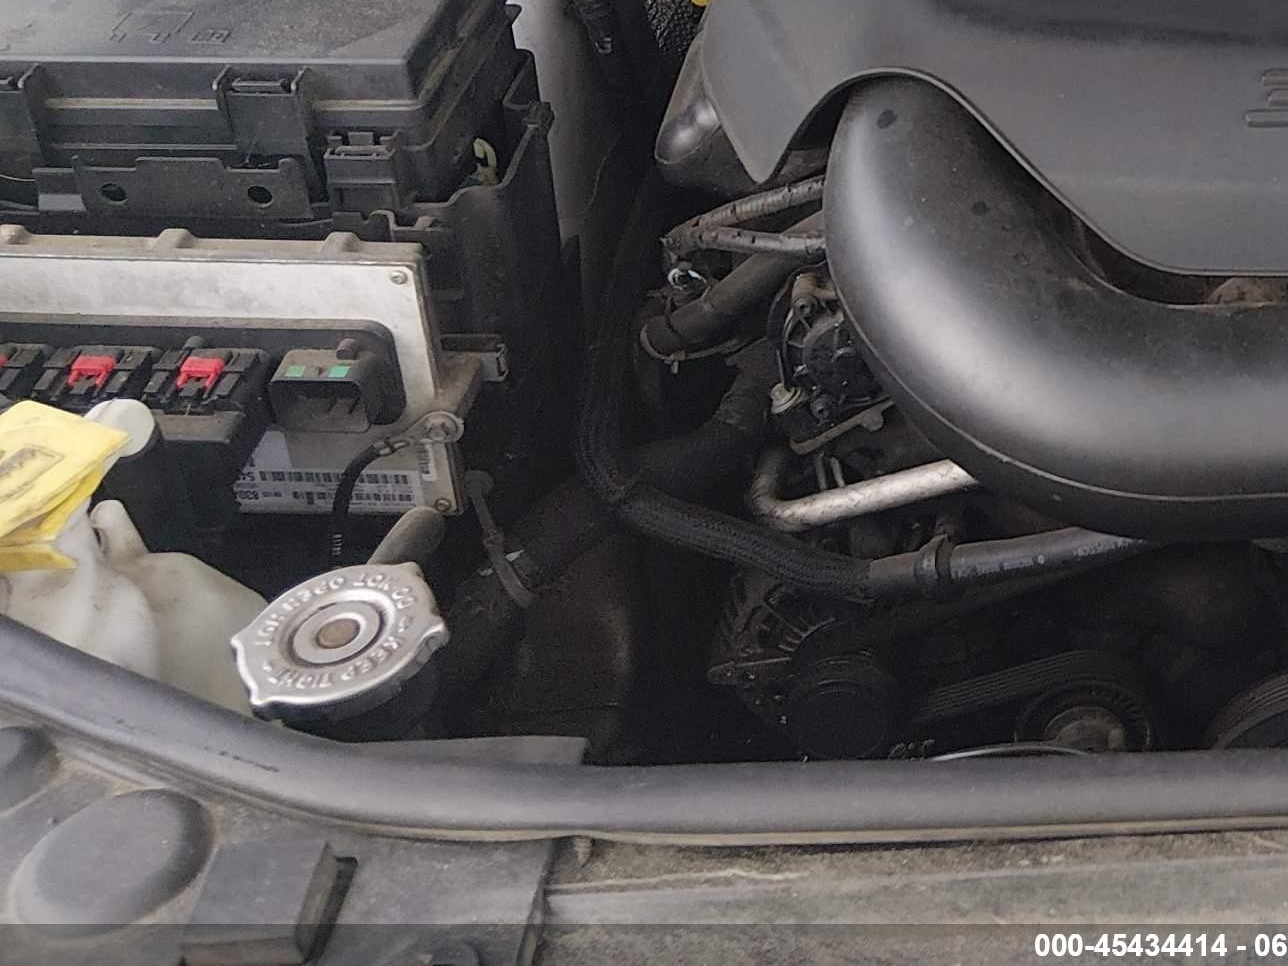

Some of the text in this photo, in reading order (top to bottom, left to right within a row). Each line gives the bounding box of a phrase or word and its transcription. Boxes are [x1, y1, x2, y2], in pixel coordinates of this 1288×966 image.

[353, 573, 394, 592] NOT
[391, 586, 416, 610] DO
[340, 635, 401, 681] KEEP
